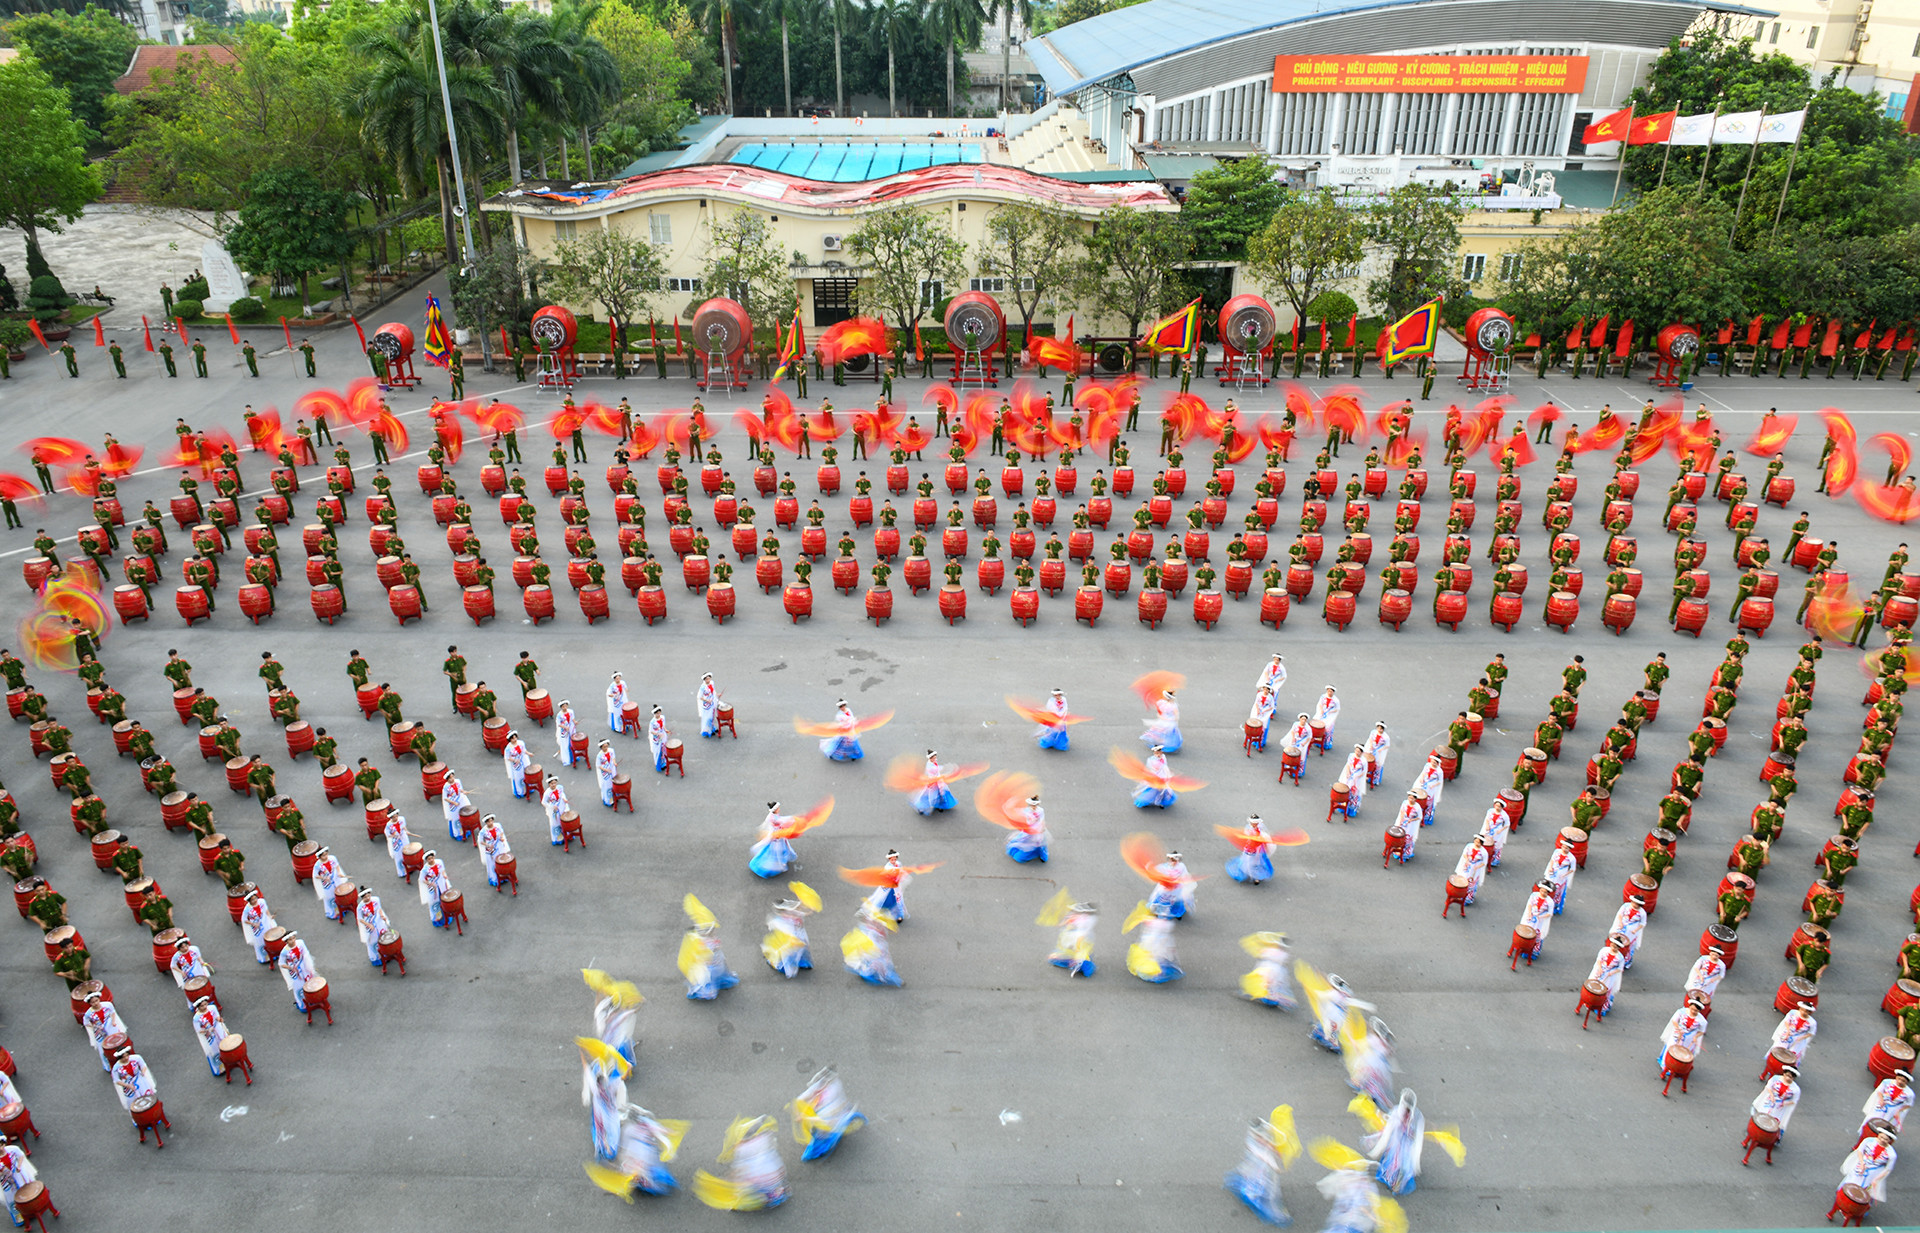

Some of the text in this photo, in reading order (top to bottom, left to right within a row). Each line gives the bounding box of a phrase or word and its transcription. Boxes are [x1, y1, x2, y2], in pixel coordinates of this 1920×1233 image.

[1293, 58, 1313, 75] CHỦ
[1314, 60, 1340, 77] ĐỘNG
[1347, 60, 1366, 75] NÊU
[1458, 61, 1488, 75] TRÁCH
[1489, 60, 1520, 77] NHIỆM
[1526, 61, 1548, 77] HIỆU
[1548, 59, 1568, 76] QUẢ
[1292, 76, 1338, 86] PROACTIVE
[1345, 76, 1395, 86] EXEMPLARY
[1402, 77, 1454, 87] DISCIPLINED
[1461, 77, 1518, 87] RESPONSIBLE
[1525, 77, 1566, 87] EFFICIENT
